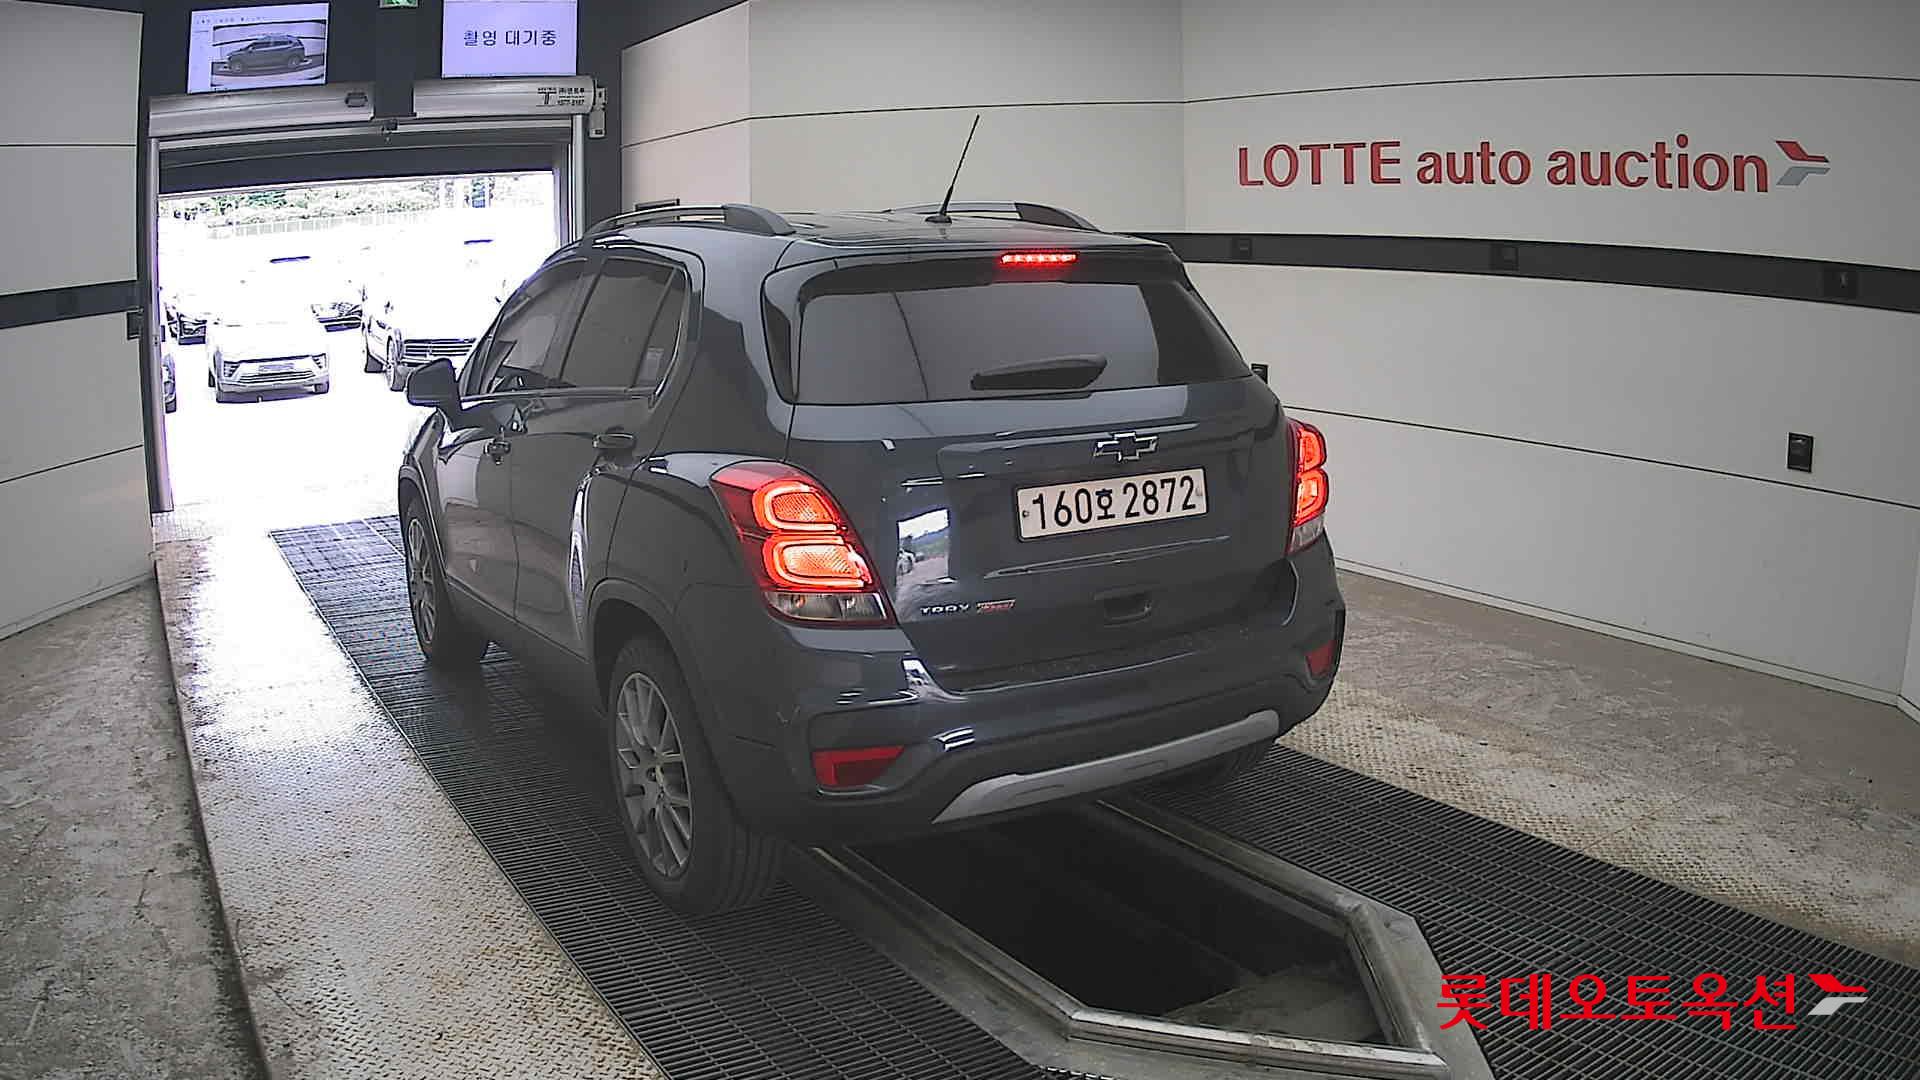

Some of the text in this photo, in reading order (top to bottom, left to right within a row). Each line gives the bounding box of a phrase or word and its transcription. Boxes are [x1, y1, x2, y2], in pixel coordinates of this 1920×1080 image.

[505, 30, 557, 46] 대기중
[1239, 134, 1769, 194] LOTTE auto auction
